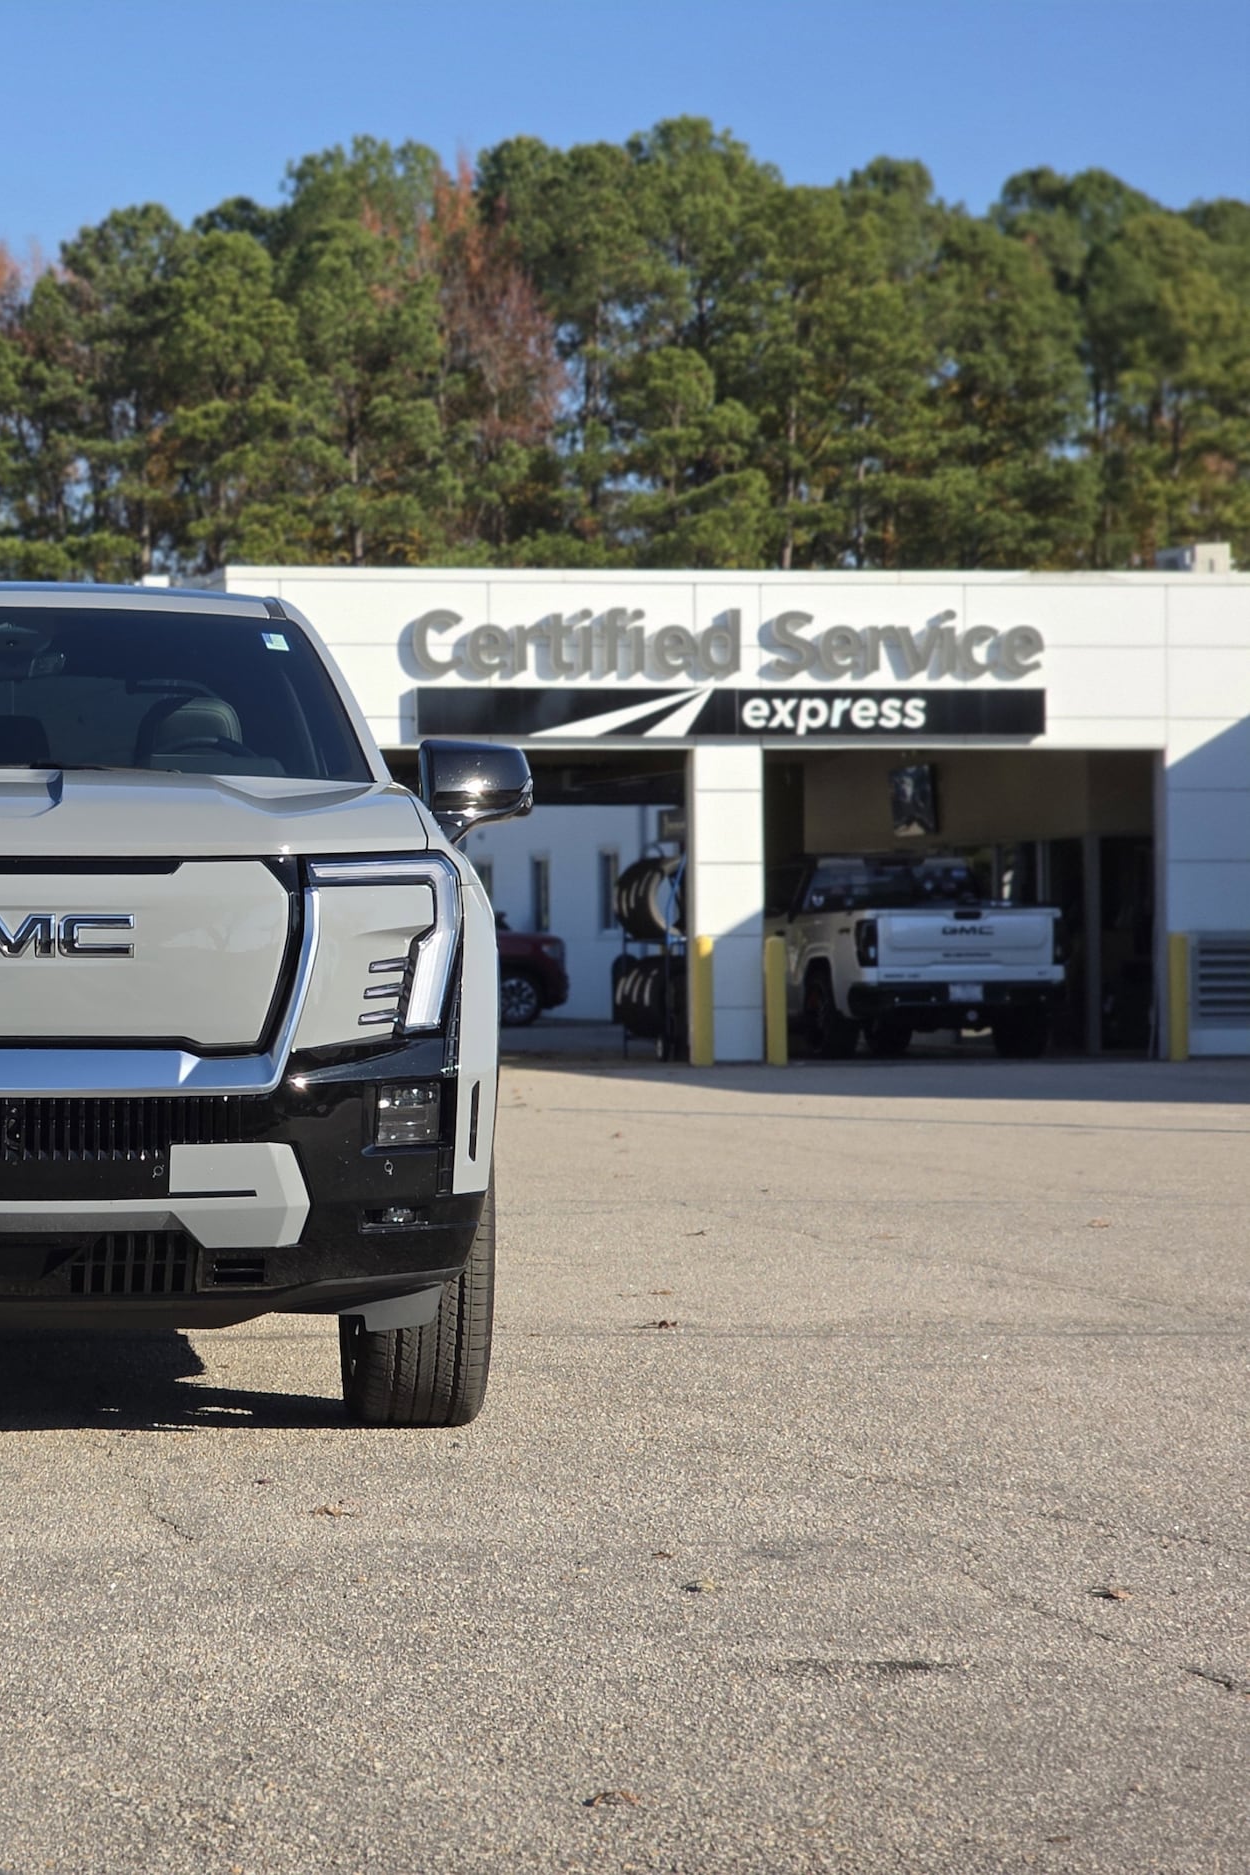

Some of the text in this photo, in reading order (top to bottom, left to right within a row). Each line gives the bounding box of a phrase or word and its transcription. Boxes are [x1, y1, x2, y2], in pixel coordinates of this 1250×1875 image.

[408, 607, 1046, 678] Certified Service
[741, 696, 927, 735] express
[941, 925, 994, 936] GMC
